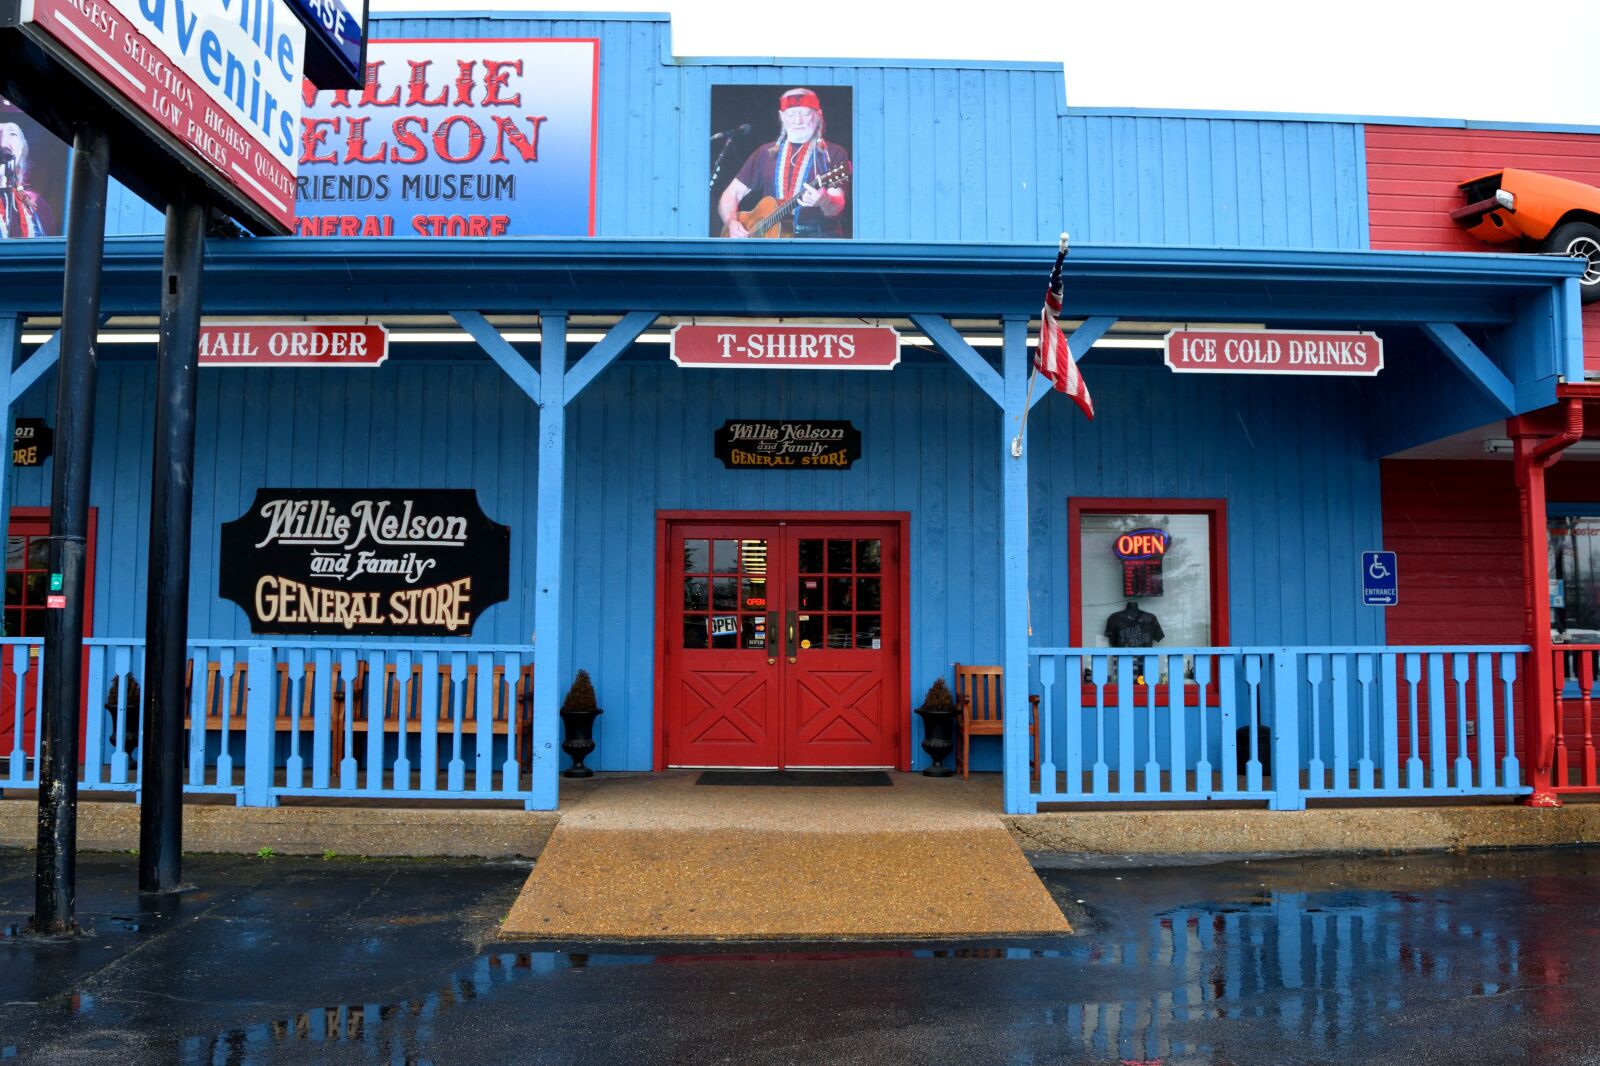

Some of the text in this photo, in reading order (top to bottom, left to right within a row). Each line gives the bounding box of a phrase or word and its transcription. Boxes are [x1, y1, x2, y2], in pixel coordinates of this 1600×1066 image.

[222, 0, 294, 83] ille
[301, 59, 524, 107] LLIE
[67, 0, 296, 200] GEST SELECTION HIGHEST QUALITY
[152, 88, 228, 167] LOW PRICES
[401, 174, 516, 202] MUSEUM
[267, 332, 368, 357] ORDER
[717, 333, 856, 359] T-SHIRTS
[1181, 338, 1367, 366] ICE COLD DRINKS
[728, 423, 844, 443] Willie Nelson
[731, 448, 848, 467] GENERAL STORE
[757, 440, 828, 457] and Family
[255, 499, 468, 550] Willie Nelson
[1118, 535, 1165, 555] OPEN
[310, 549, 436, 584] and Family
[255, 574, 472, 631] GENERAL STORE
[747, 598, 766, 606] OPEN
[1365, 588, 1396, 596] ENTRANCE
